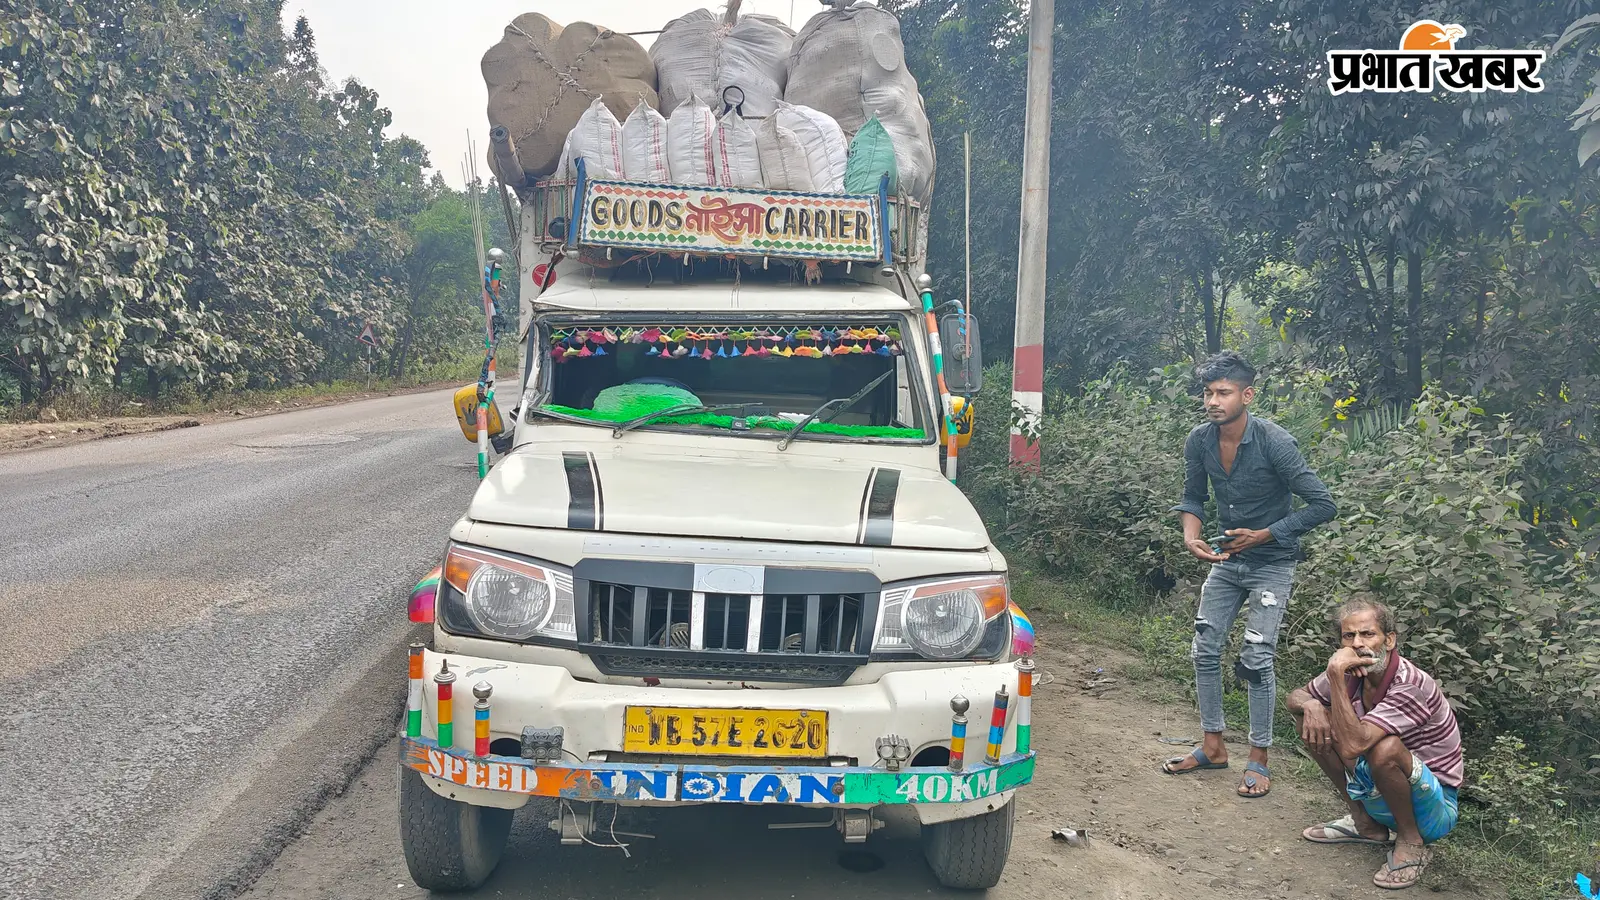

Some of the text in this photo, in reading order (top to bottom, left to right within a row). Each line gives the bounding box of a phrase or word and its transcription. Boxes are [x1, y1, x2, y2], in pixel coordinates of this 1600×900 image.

[590, 195, 684, 231] GOODS
[765, 204, 871, 242] CARRIER
[628, 724, 644, 733] IND
[648, 714, 682, 746] WB
[692, 715, 744, 748] 57E
[427, 749, 999, 804] SPEED INDIAN 40KM
